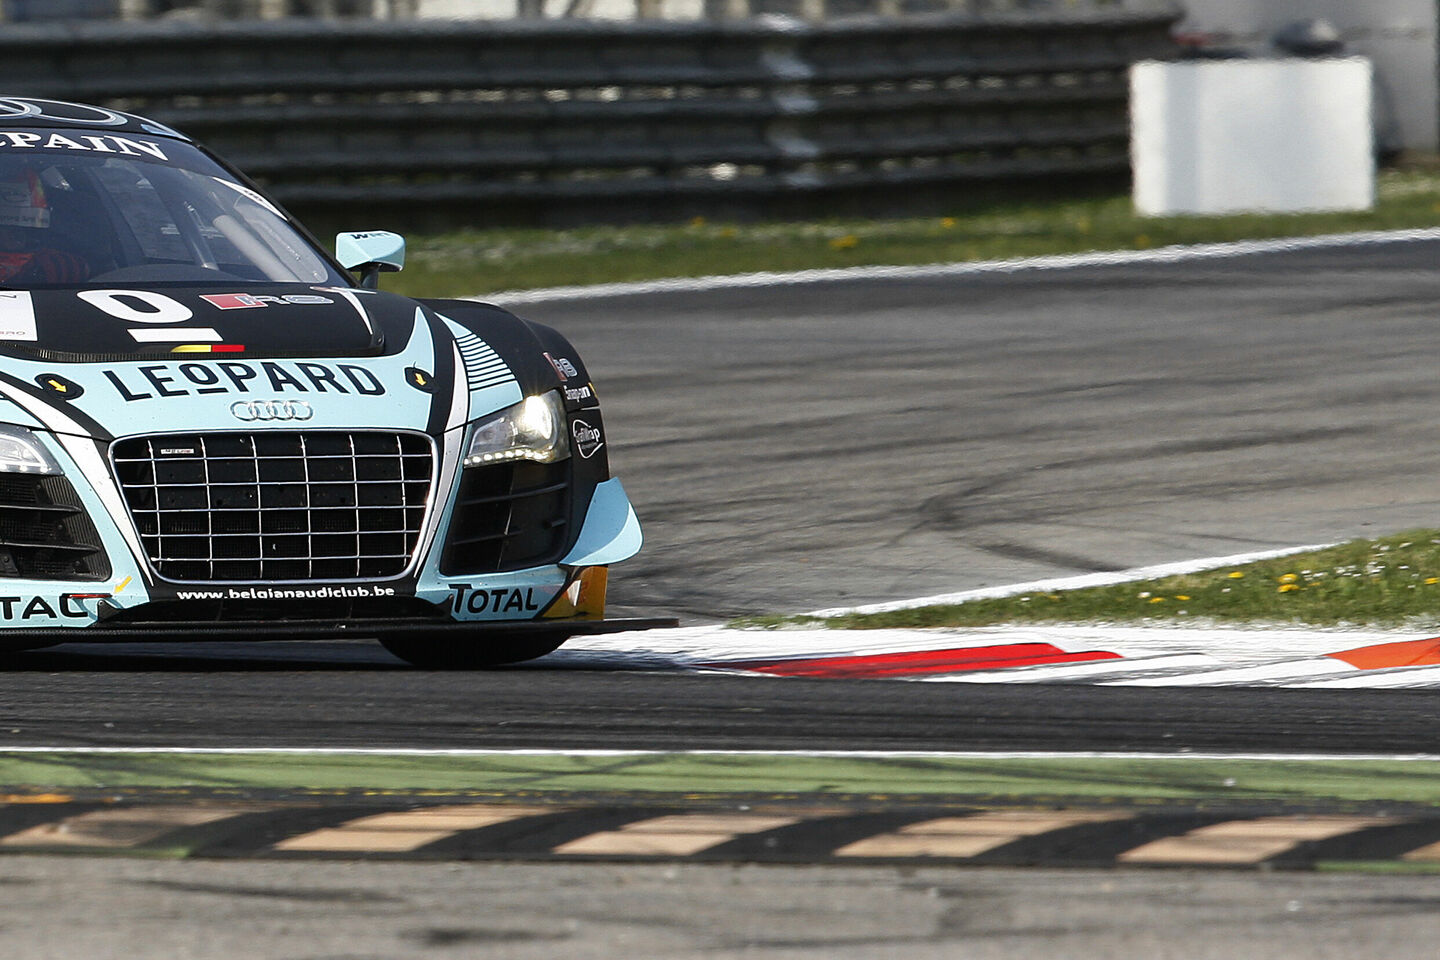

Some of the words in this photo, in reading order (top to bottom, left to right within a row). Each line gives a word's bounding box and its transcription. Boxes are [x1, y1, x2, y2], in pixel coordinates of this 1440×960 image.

[102, 362, 386, 401] LEOPARD
[177, 586, 395, 600] www.belgianaudiclub.be
[448, 583, 538, 614] TOTAL
